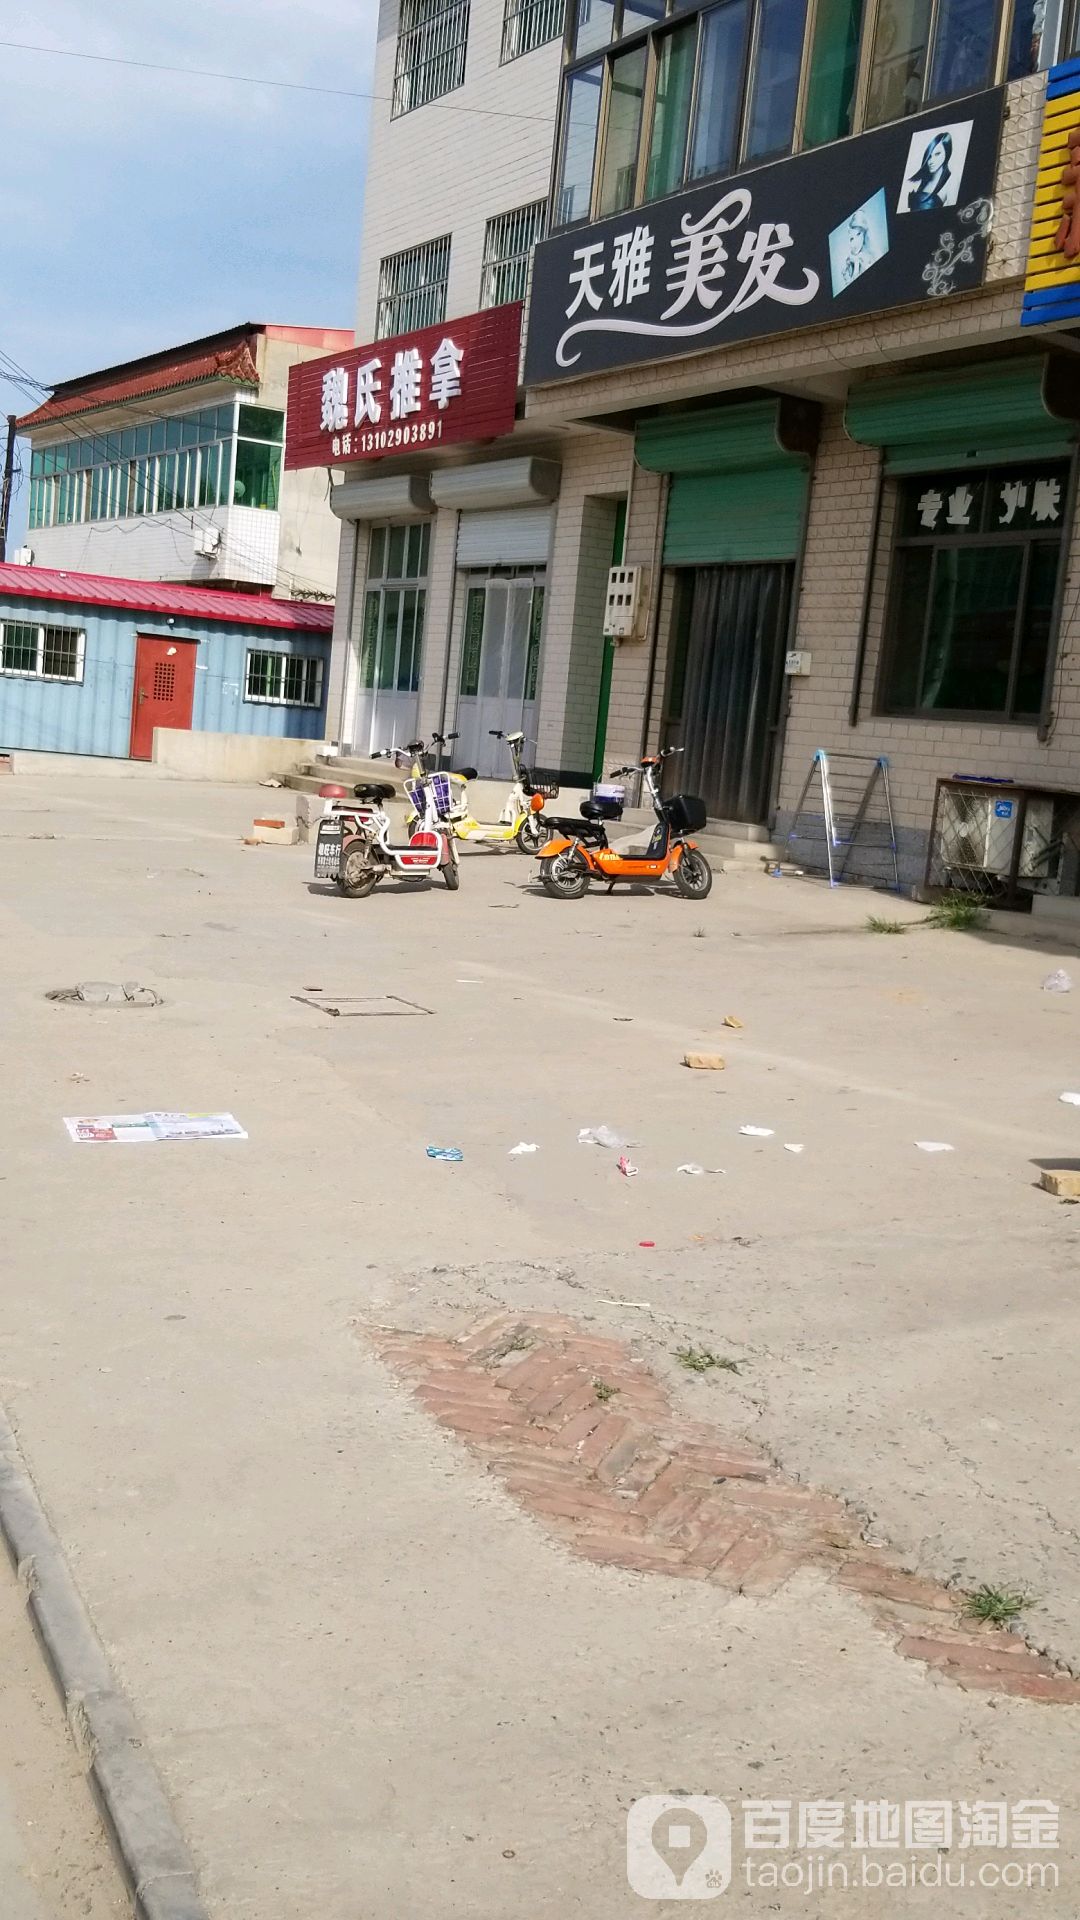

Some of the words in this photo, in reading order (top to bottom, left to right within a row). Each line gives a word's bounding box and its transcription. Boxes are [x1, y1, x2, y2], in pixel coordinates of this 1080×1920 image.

[556, 188, 819, 367] 天雅美发
[321, 338, 464, 431] 魏氏推拿
[918, 489, 973, 530] 专业
